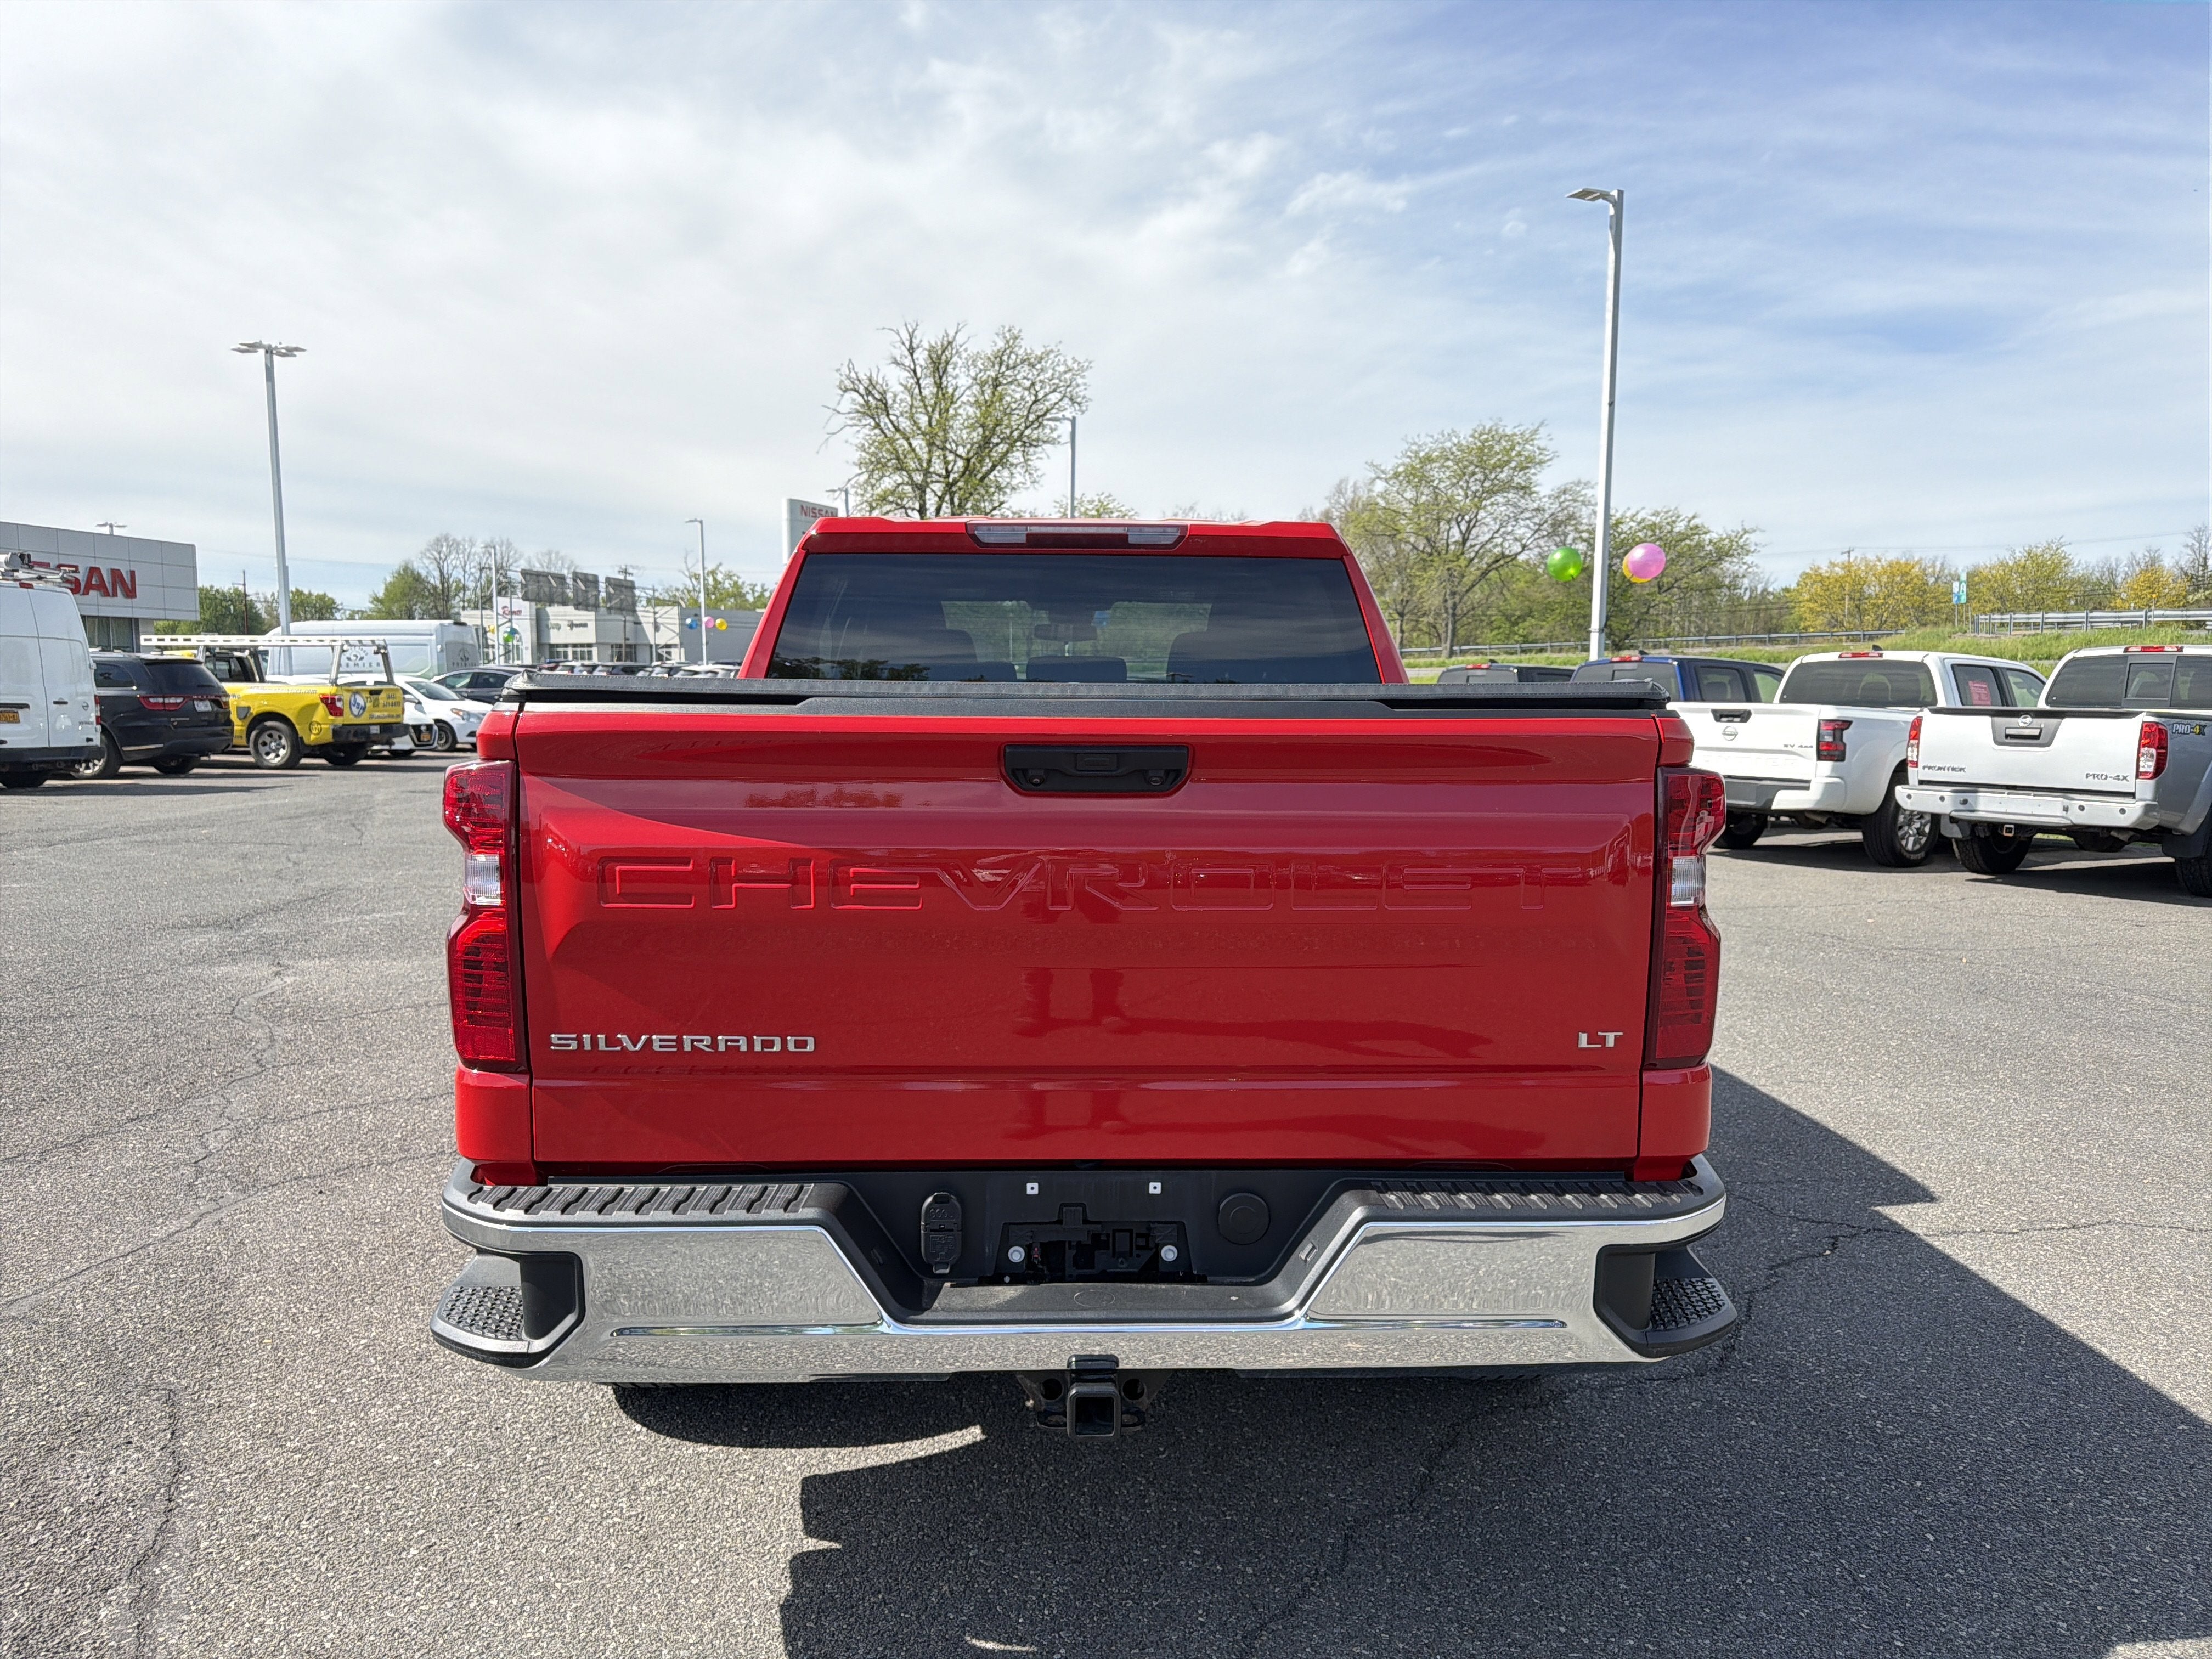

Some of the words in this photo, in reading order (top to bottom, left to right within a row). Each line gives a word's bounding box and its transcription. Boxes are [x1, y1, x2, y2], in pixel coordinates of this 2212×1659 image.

[2172, 723, 2207, 736] PRO-4X
[1922, 765, 1966, 773] FRONTIER
[2085, 772, 2130, 782] PRO-4X
[599, 856, 1581, 911] CHEVROLET
[549, 1033, 816, 1052] SILVERADO
[1578, 1031, 1623, 1048] LT
